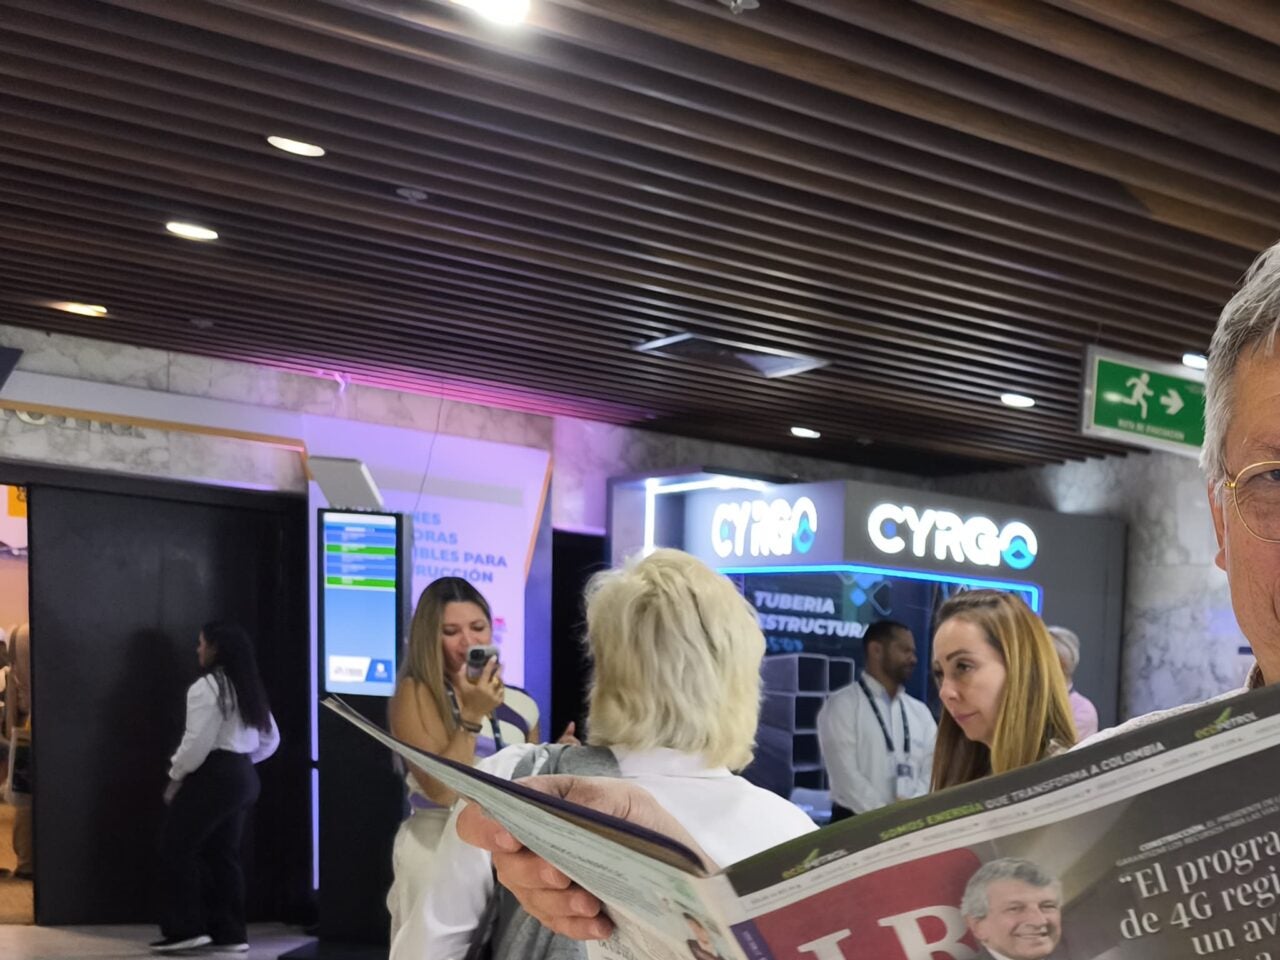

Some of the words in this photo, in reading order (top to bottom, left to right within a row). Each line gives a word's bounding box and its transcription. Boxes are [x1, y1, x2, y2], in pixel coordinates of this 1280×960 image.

[711, 497, 817, 557] CYRGO
[867, 502, 1038, 569] CYRGO
[464, 551, 507, 567] PARA
[754, 590, 835, 614] TUBERIA
[879, 819, 925, 840] SOMOS
[985, 795, 1009, 810] QUE
[1010, 768, 1090, 802] TRANSFORMA
[1089, 763, 1101, 776] A
[1101, 741, 1166, 772] COLOMBIA
[1120, 909, 1161, 940] de
[1169, 892, 1213, 929] 4G
[1191, 926, 1236, 956] un
